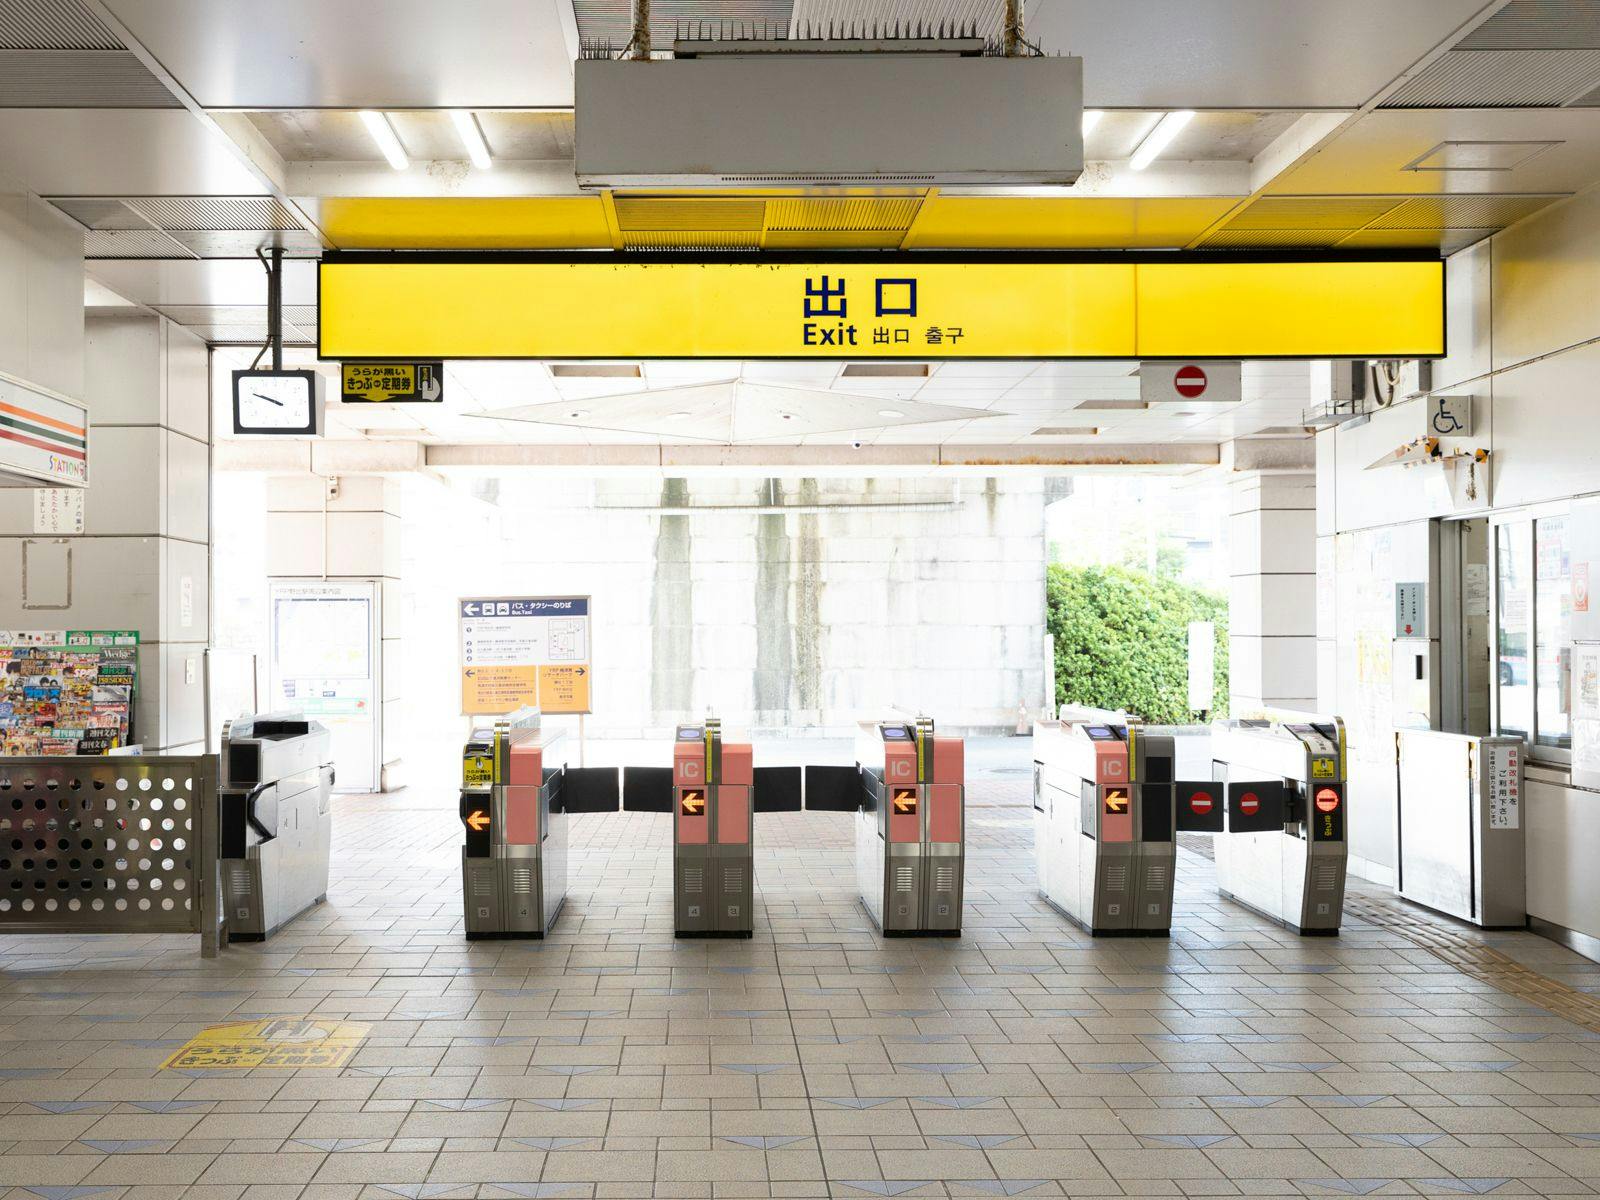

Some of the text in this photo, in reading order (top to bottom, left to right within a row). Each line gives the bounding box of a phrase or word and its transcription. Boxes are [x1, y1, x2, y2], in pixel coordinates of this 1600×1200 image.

[803, 275, 917, 318] 出口
[803, 322, 964, 346] Exit 出口 출구
[352, 367, 407, 377] うらが黒い
[49, 454, 79, 476] STATION
[679, 761, 699, 778] IC
[891, 759, 911, 777] IC
[1103, 760, 1122, 776] IC
[1508, 750, 1518, 806] 自動改札機を
